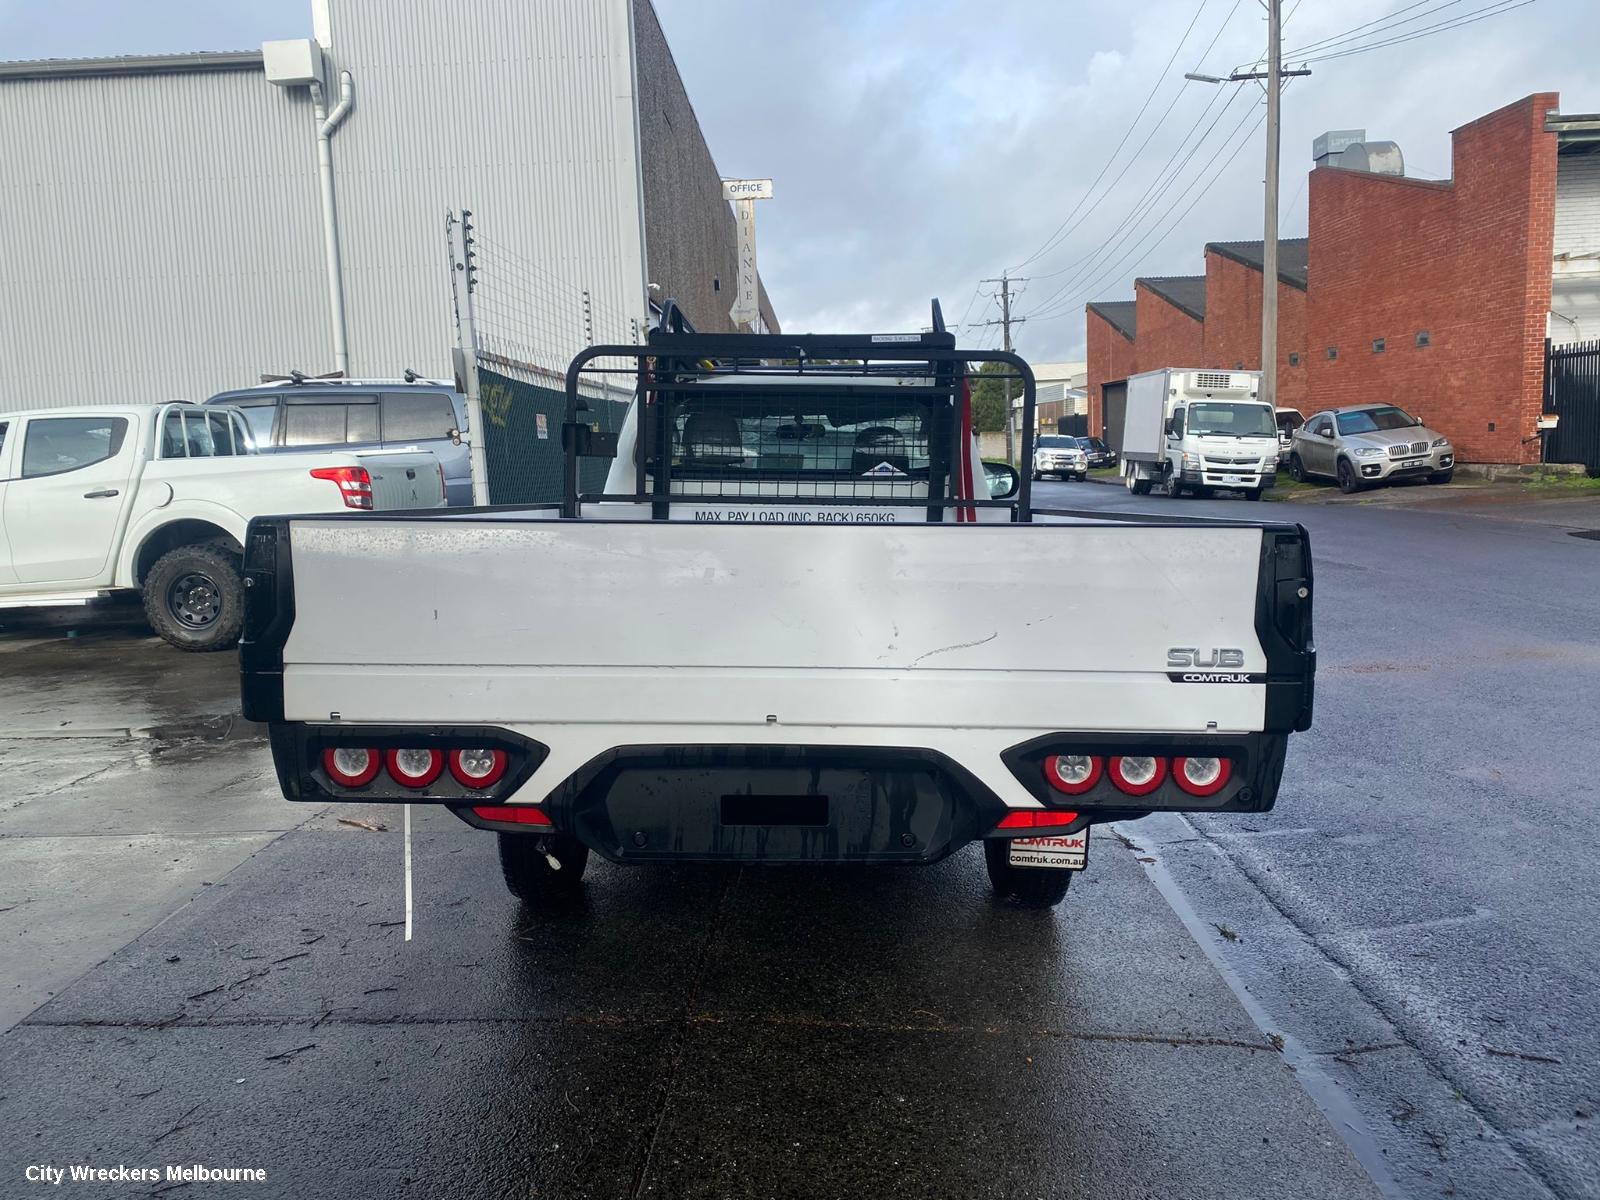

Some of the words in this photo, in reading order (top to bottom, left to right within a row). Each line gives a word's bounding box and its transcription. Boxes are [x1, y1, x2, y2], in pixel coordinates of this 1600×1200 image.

[730, 184, 762, 193] OFFICE
[741, 210, 753, 300] DIANNE
[856, 513, 895, 522] 650KG
[1167, 647, 1245, 669] SUB
[1182, 673, 1251, 683] COMTRUK
[1012, 837, 1084, 848] COMTRUK
[1010, 855, 1084, 866] comtruk.com.au
